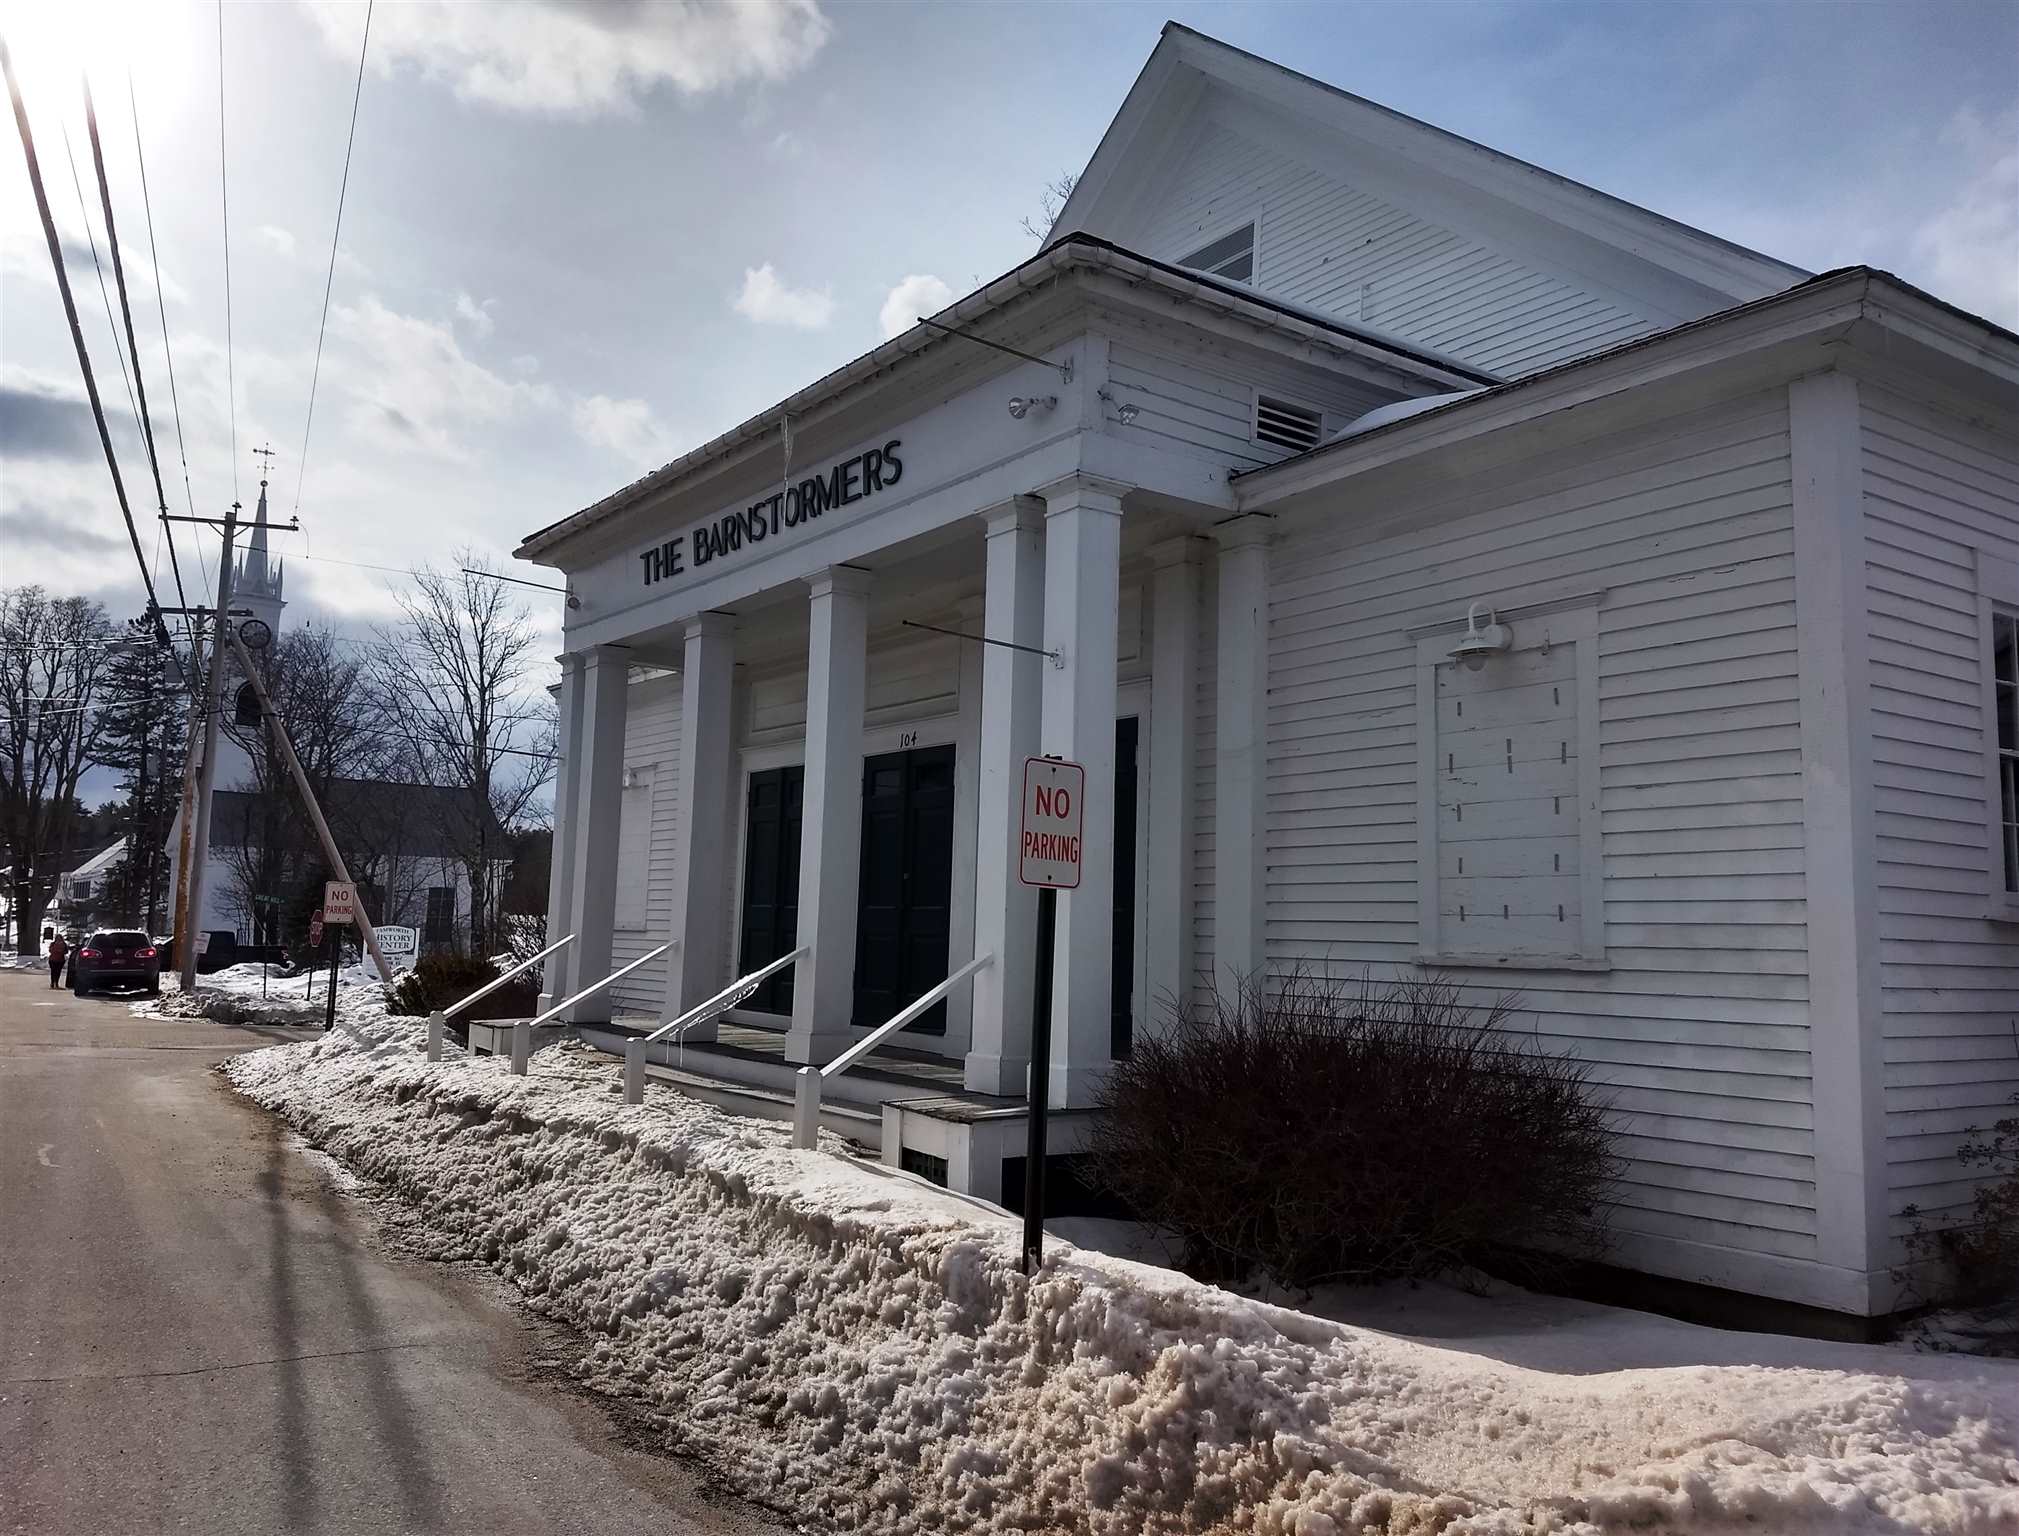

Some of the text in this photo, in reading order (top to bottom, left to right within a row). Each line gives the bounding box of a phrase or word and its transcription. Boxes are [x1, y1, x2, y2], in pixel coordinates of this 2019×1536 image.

[640, 440, 903, 586] THE BARNSTORMERS
[900, 730, 917, 748] 104
[1035, 784, 1070, 819] NO
[1023, 831, 1079, 864] PARKING
[331, 890, 349, 901] NO
[326, 905, 353, 915] PARKING
[312, 921, 323, 935] STOP
